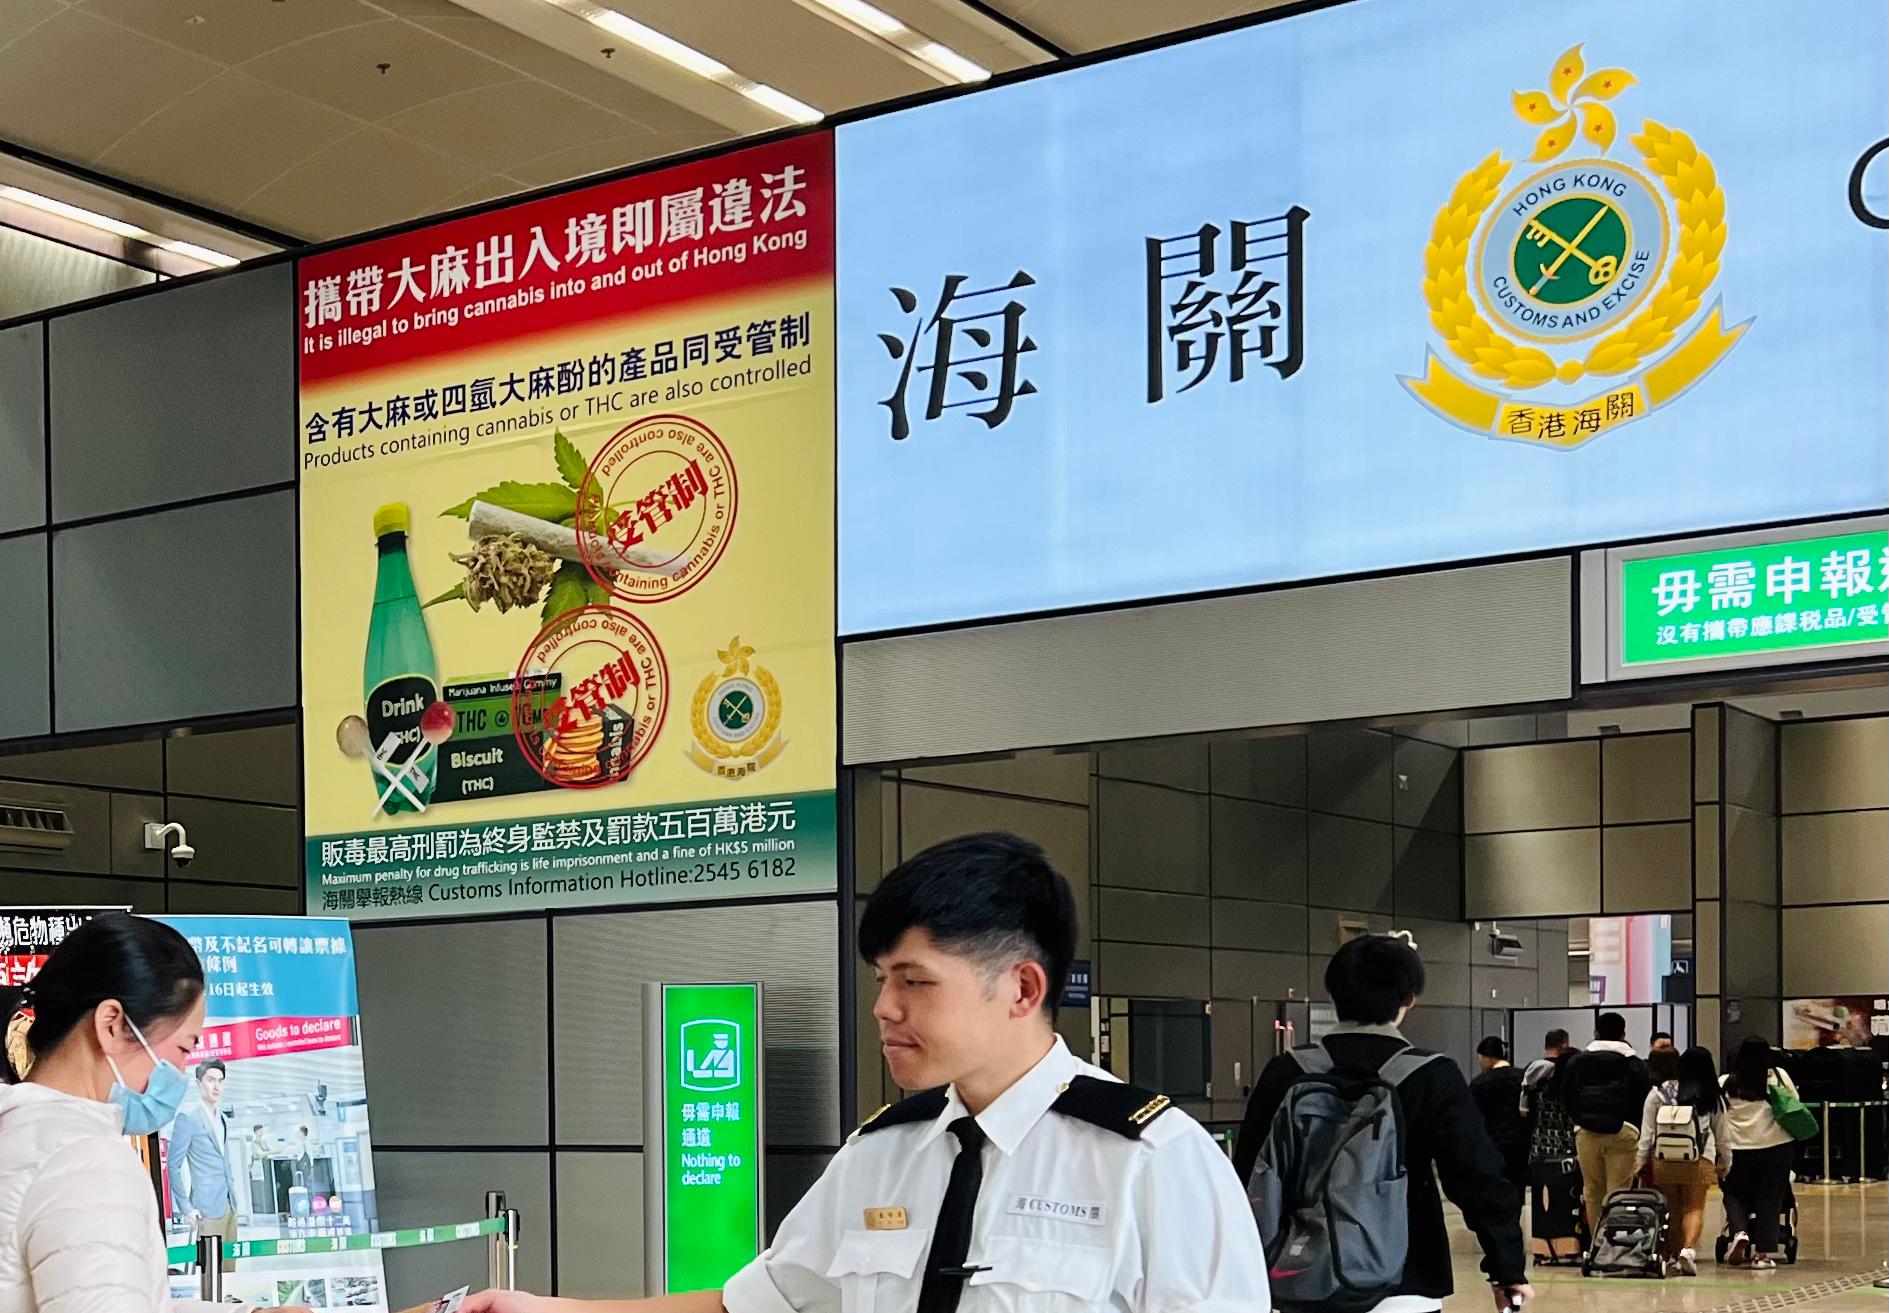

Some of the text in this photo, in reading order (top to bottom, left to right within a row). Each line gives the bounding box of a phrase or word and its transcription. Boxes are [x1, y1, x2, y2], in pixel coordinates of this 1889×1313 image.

[1512, 173, 1627, 217] HONG KONG
[304, 165, 807, 329] 攜帶大麻出入境即屬違法
[304, 229, 808, 355] It is illegal to bring cannabis into and out of Hong Kong
[1493, 249, 1651, 329] CUSTOMS AND EXCISE
[876, 205, 1311, 441] 海關
[305, 311, 810, 445] 含有大麻或四氫大麻酚的產品同受管制
[304, 353, 812, 470] Products containing cannabis or THC are also controlled
[1507, 391, 1635, 439] 香港海關
[601, 429, 665, 477] controlled
[668, 428, 696, 446] also
[696, 442, 715, 464] are
[709, 465, 725, 500] THC
[607, 458, 710, 555] 受管制
[714, 503, 725, 520] or
[671, 523, 721, 582] cannabis
[1652, 546, 1889, 617] 毋需申報
[601, 618, 629, 636] also
[628, 633, 648, 655] are
[640, 656, 658, 691] THC
[381, 692, 425, 718] Drink
[456, 708, 487, 734] THC
[451, 747, 504, 769] Biscuit
[462, 776, 495, 795] (THC)
[322, 838, 796, 886] Maximum penalty for drug trafficking is life imprisonment and a fine of HK$5 million
[428, 882, 503, 902] Customs
[508, 871, 614, 896] Information
[747, 857, 796, 879] 6182
[255, 1018, 342, 1042] Goods to declare
[681, 1101, 741, 1123] 毋需申報
[681, 1127, 712, 1147] 通道
[681, 1152, 742, 1171] Nothing to
[681, 1169, 722, 1185] declare
[1028, 1196, 1089, 1220] CUSTOMS
